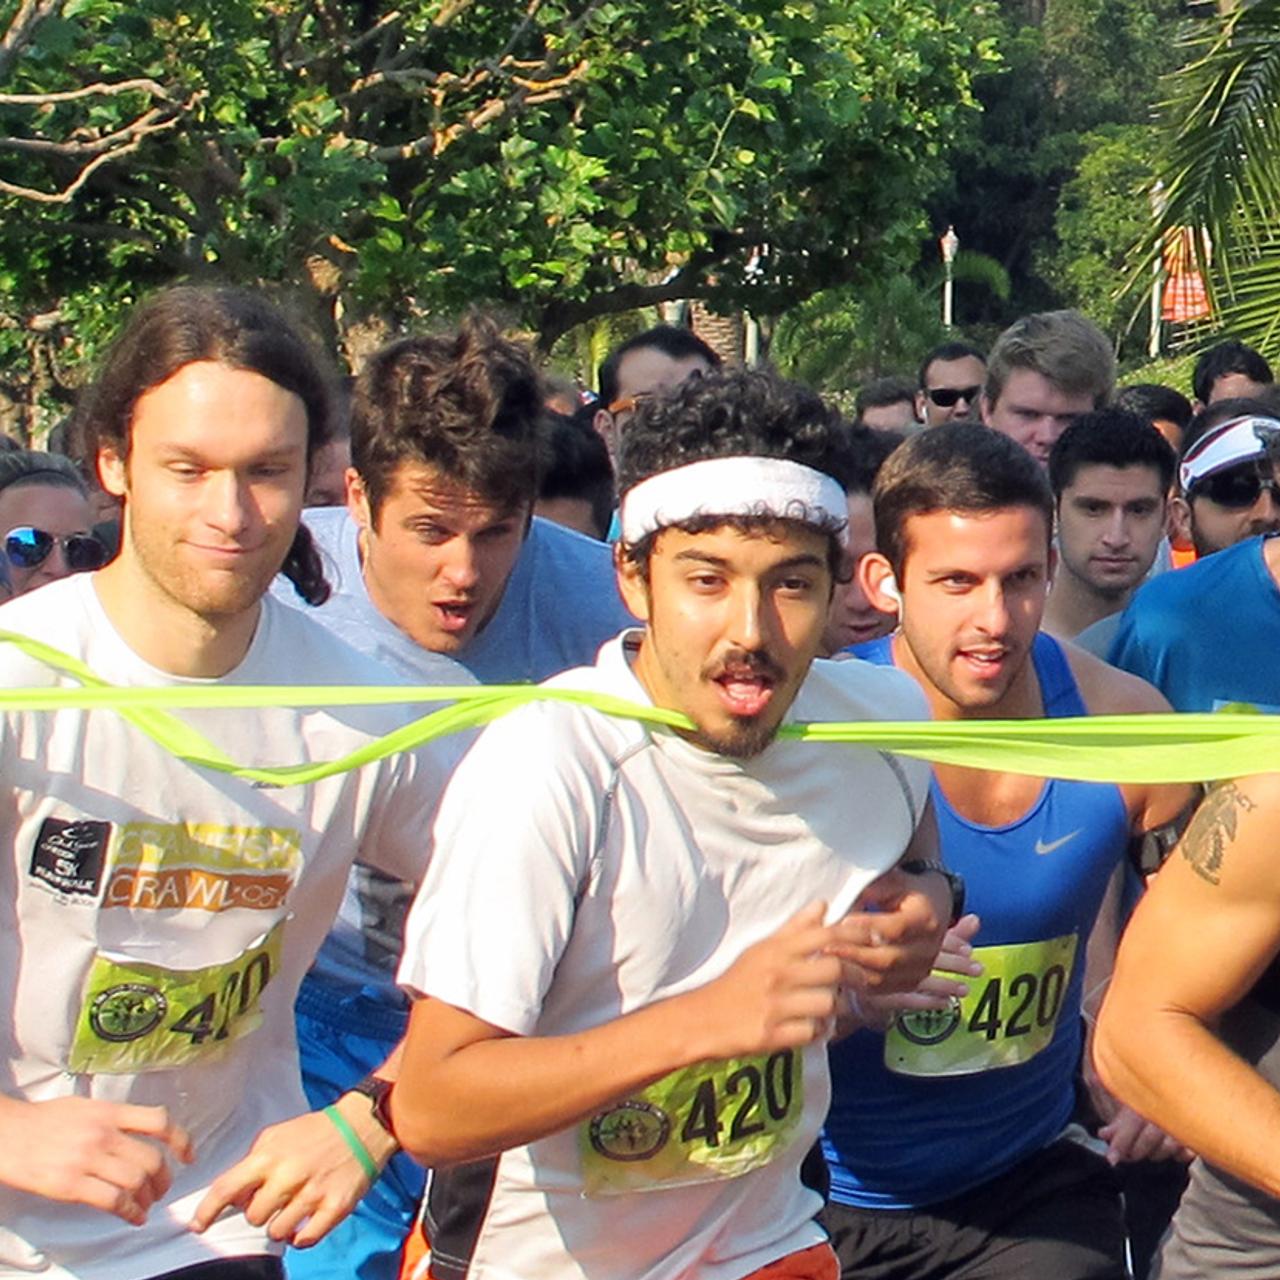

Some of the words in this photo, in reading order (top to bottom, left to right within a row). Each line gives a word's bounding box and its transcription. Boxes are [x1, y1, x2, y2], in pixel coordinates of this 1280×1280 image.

[107, 873, 234, 909] CRAWL
[968, 963, 1066, 1043] 420
[681, 1047, 794, 1149] 420
